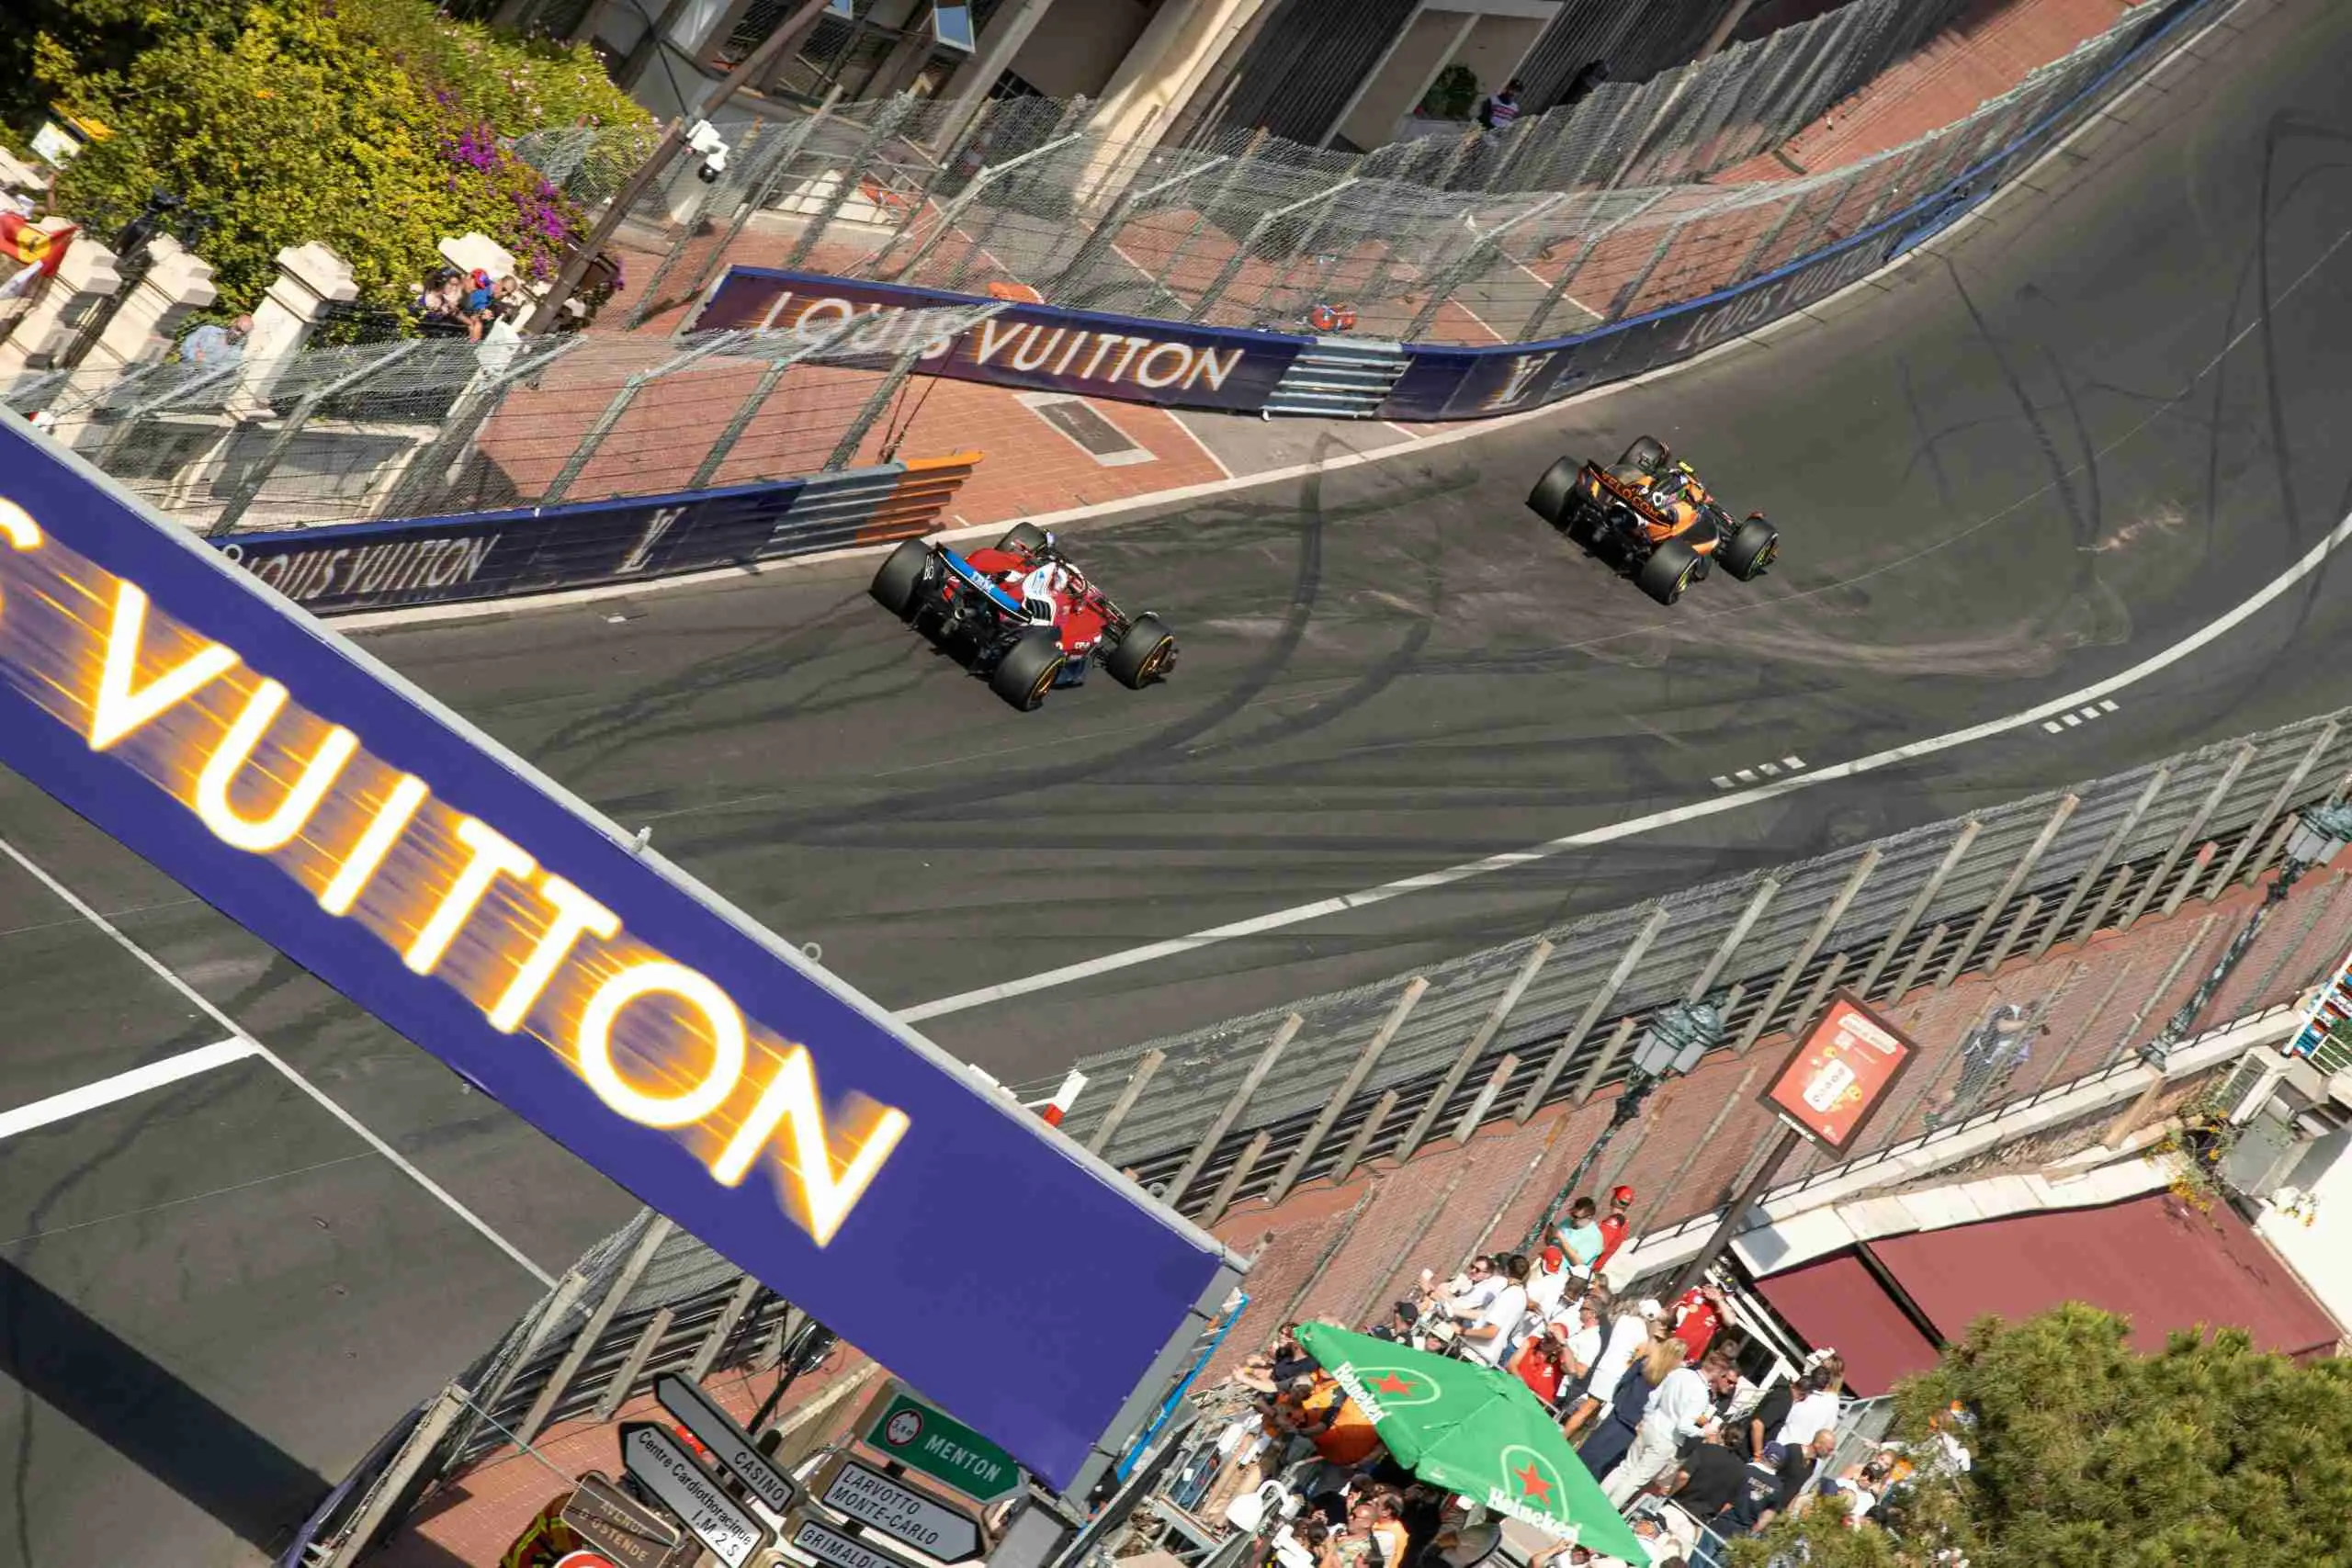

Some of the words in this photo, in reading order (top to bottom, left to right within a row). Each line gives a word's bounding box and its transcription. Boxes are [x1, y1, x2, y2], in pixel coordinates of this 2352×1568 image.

[749, 290, 952, 360] LOUIS
[978, 320, 1244, 391] VUITTON
[1678, 282, 1782, 351] LOUIS
[341, 533, 501, 594] VUITTON
[87, 578, 910, 1247] VUITTON
[1332, 1360, 1392, 1426] Heineken
[638, 1430, 673, 1467] Centre
[672, 1462, 752, 1546] Cardiothoracique
[735, 1450, 786, 1503] CASINO
[923, 1434, 1001, 1483] MENTON
[831, 1486, 940, 1546] MONTE-CARLO
[842, 1470, 922, 1516] LARVOTTO
[1486, 1486, 1582, 1546] Heineken
